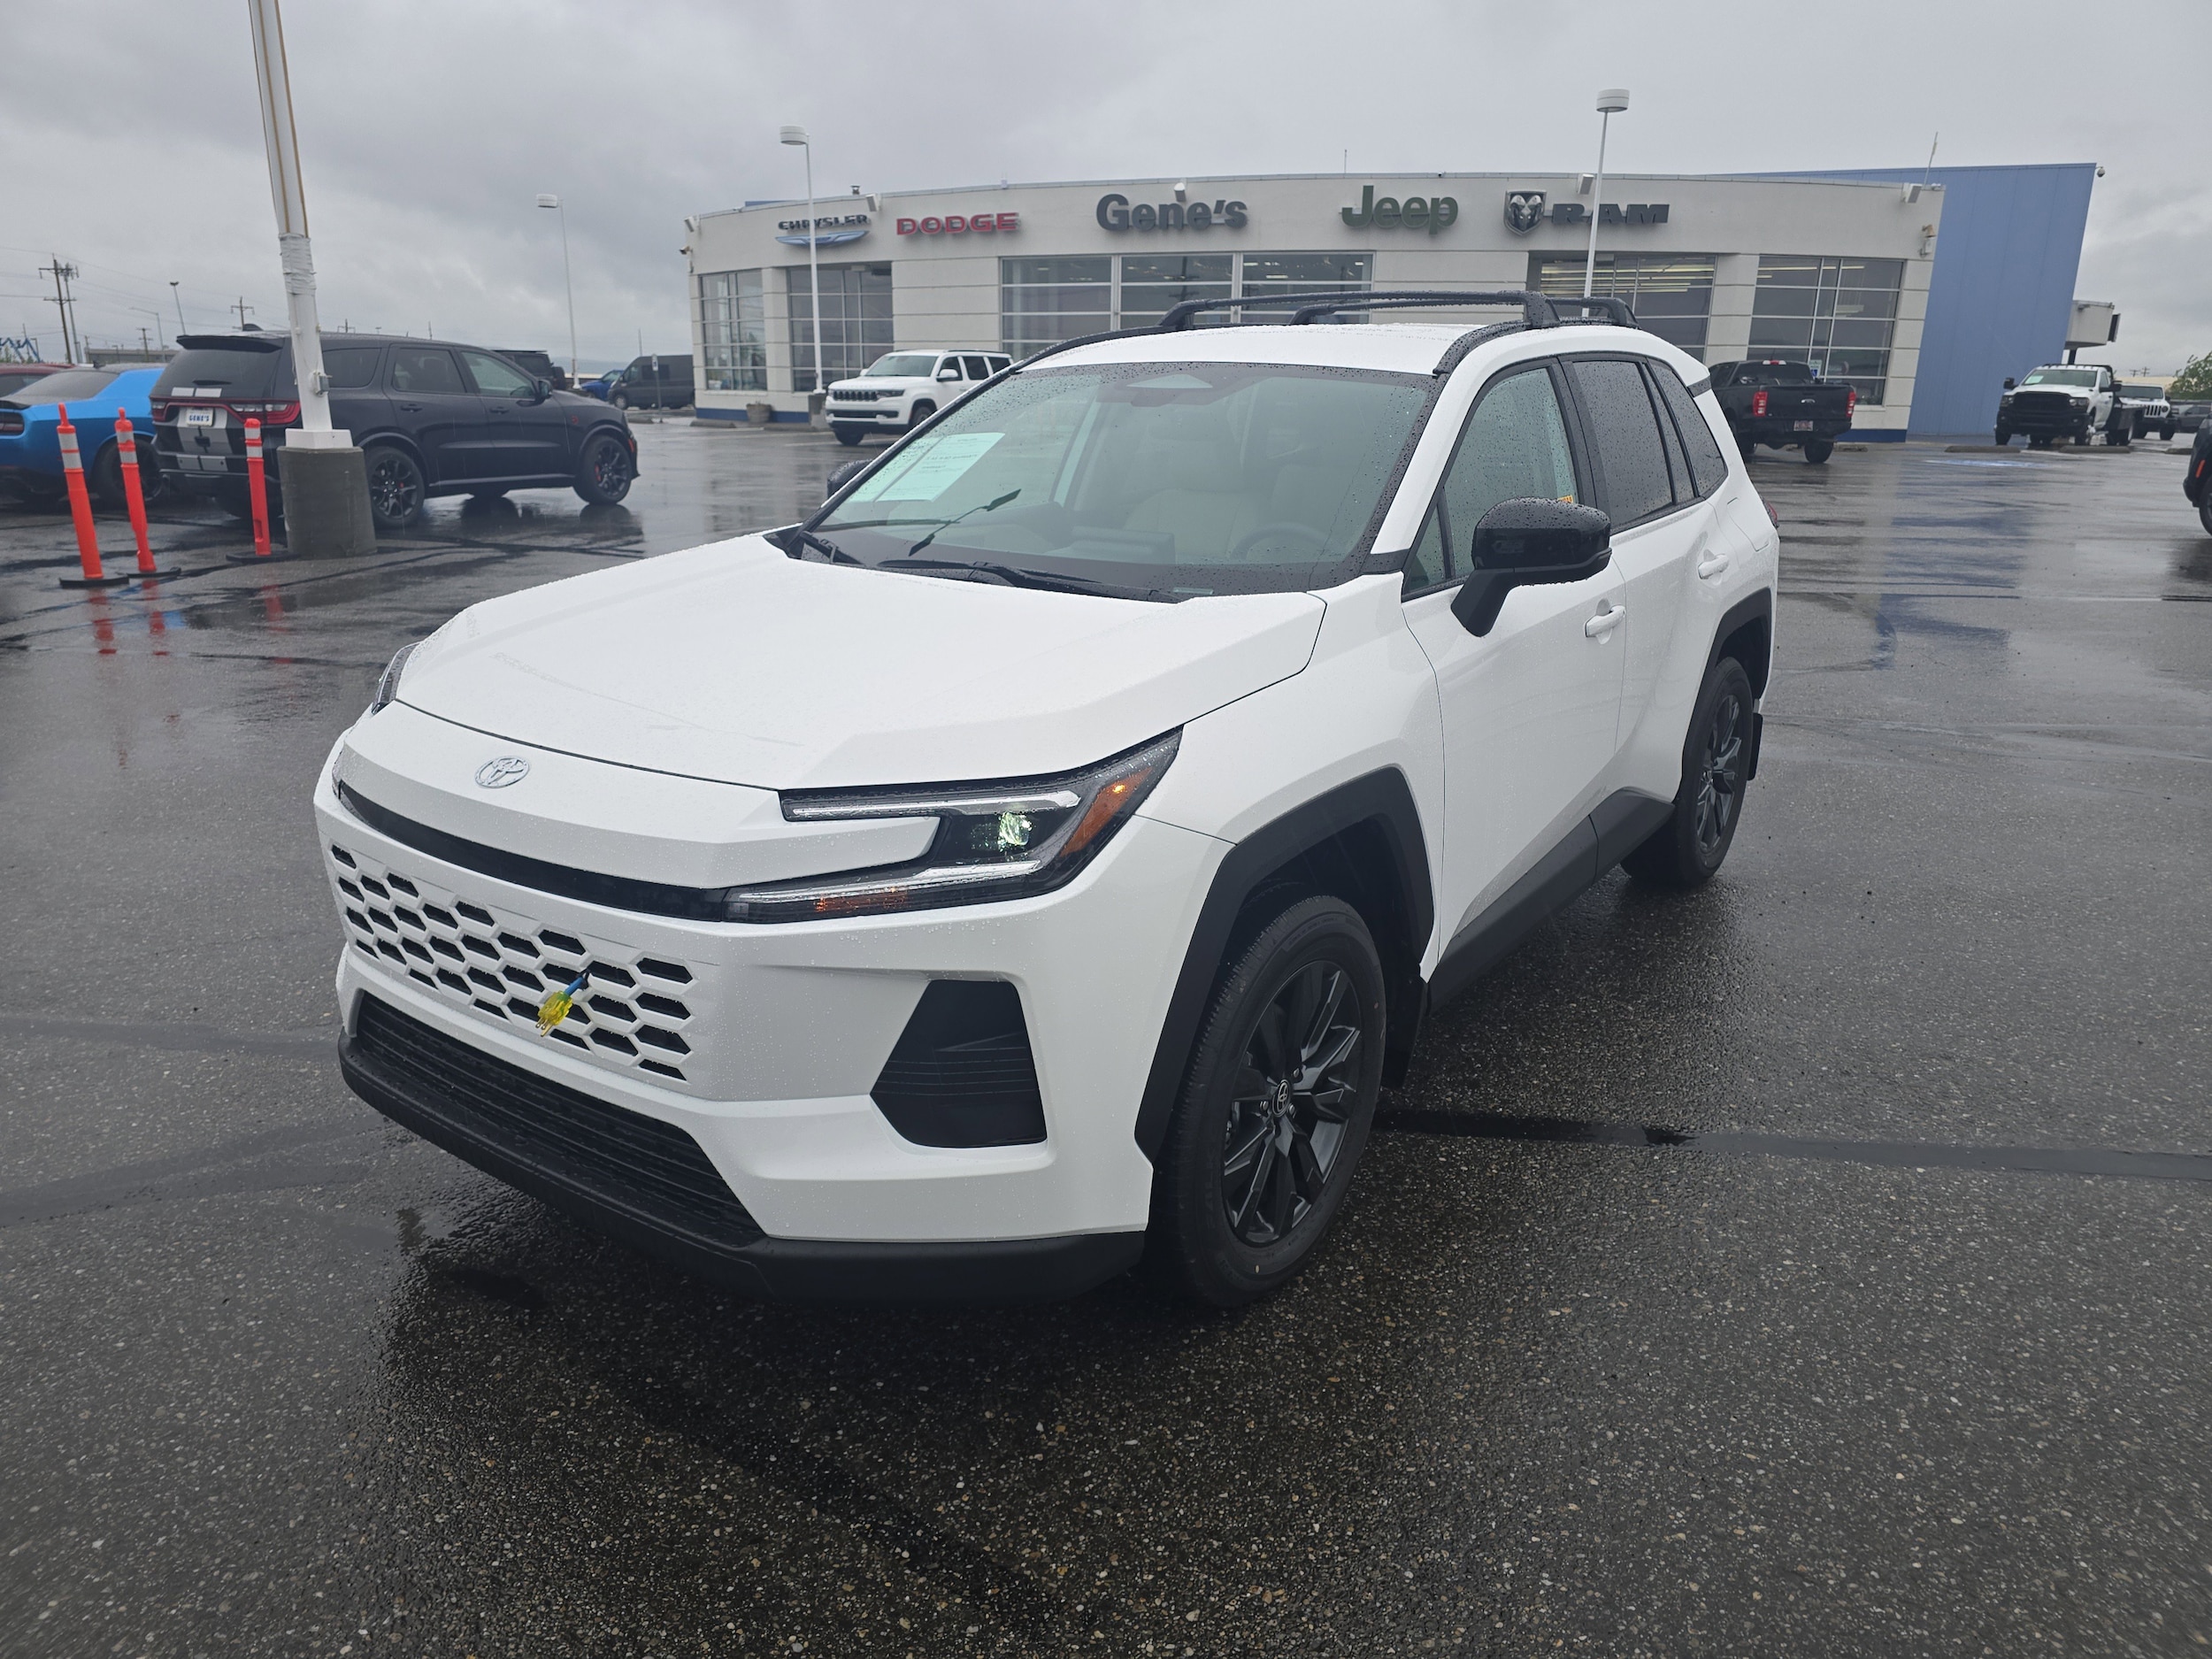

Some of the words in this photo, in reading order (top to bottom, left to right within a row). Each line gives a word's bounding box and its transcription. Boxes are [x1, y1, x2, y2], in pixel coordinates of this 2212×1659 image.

[778, 213, 870, 230] CHRYSLER
[1095, 193, 1248, 233] Gene's
[1341, 184, 1459, 235] Jeep
[1553, 204, 1670, 224] RAM
[896, 211, 1020, 236] DODGE
